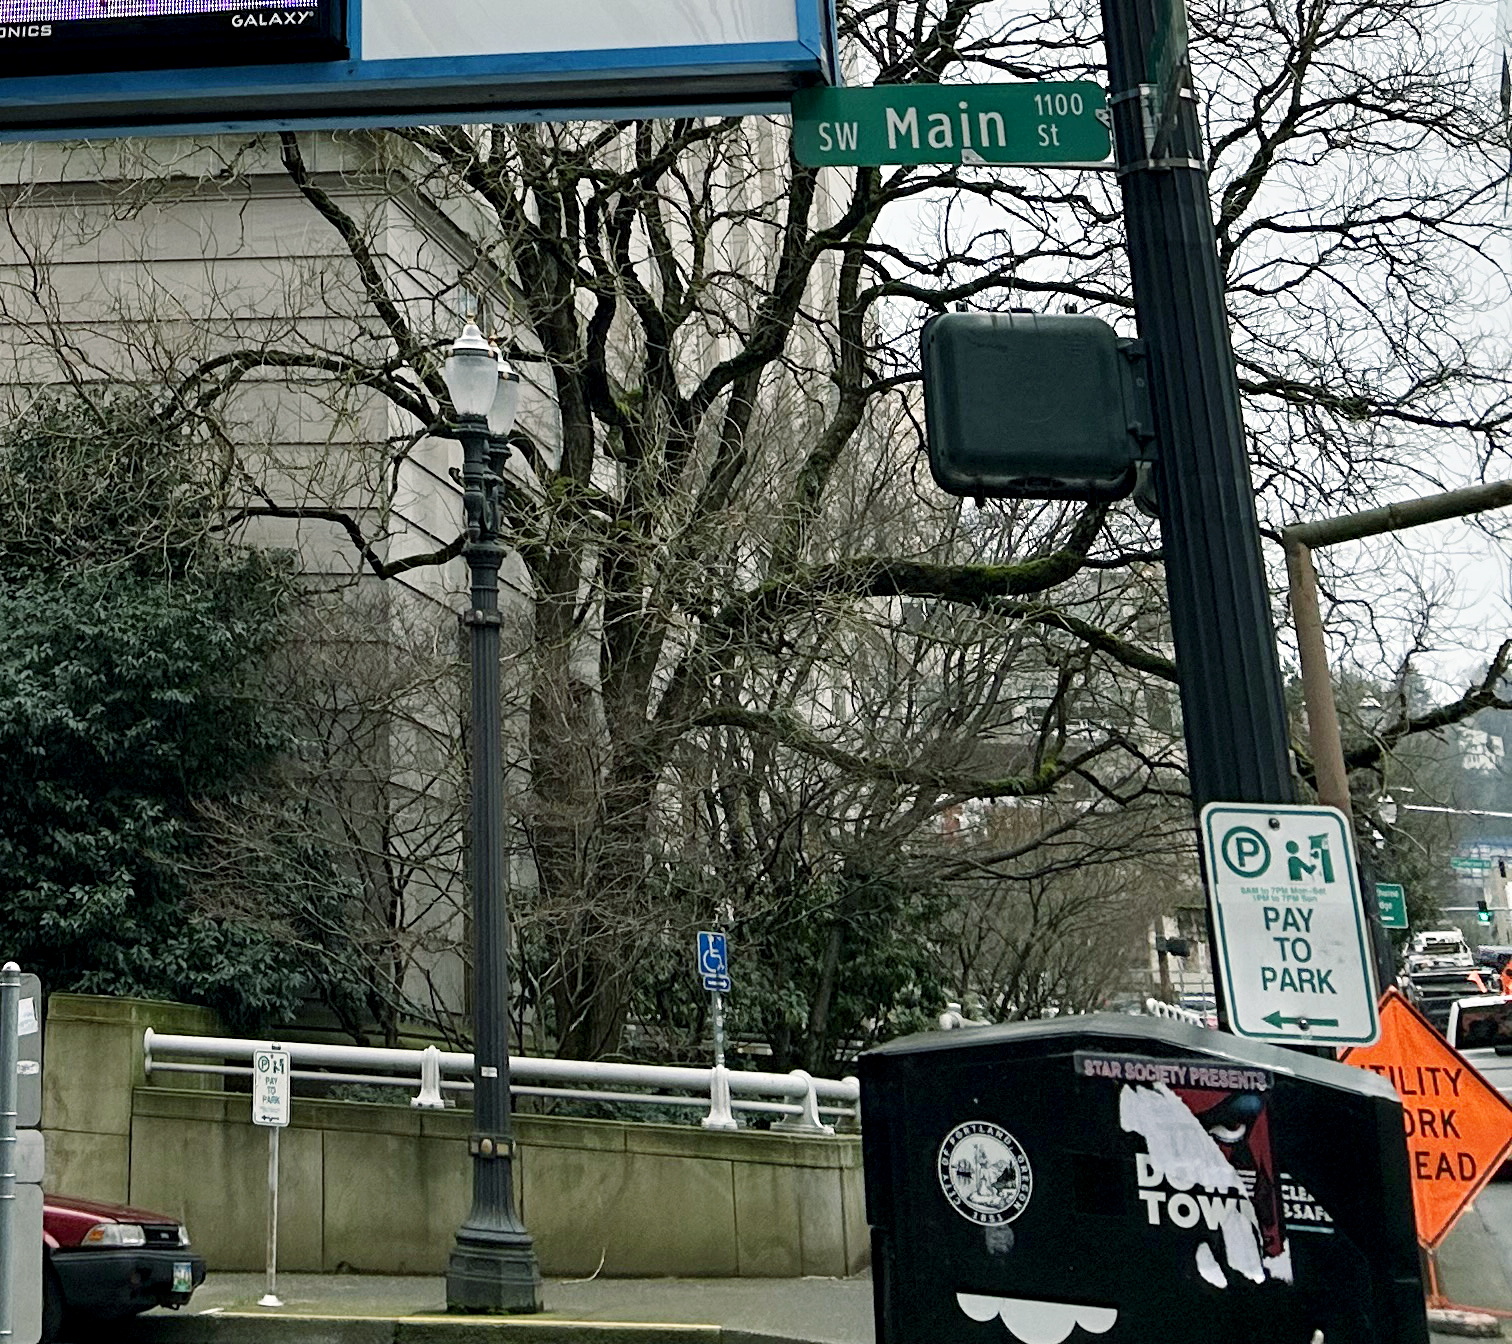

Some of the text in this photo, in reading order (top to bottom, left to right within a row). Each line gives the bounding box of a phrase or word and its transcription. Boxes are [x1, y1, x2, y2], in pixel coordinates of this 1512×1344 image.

[1034, 93, 1084, 116] 1100
[818, 100, 1060, 152] SW Main St
[1263, 906, 1313, 933] PAY
[1273, 936, 1312, 963] TO
[1261, 966, 1337, 994] PARK
[265, 1076, 278, 1085] PAY
[1085, 1059, 1268, 1092] STAR SOCIETY PRESENTS
[262, 1095, 280, 1105] PARK
[267, 1086, 277, 1095] TO
[1403, 1108, 1461, 1139] ORK
[1415, 1151, 1477, 1181] EAD
[943, 1173, 961, 1206] CITY
[1013, 1154, 1030, 1211] OREGON
